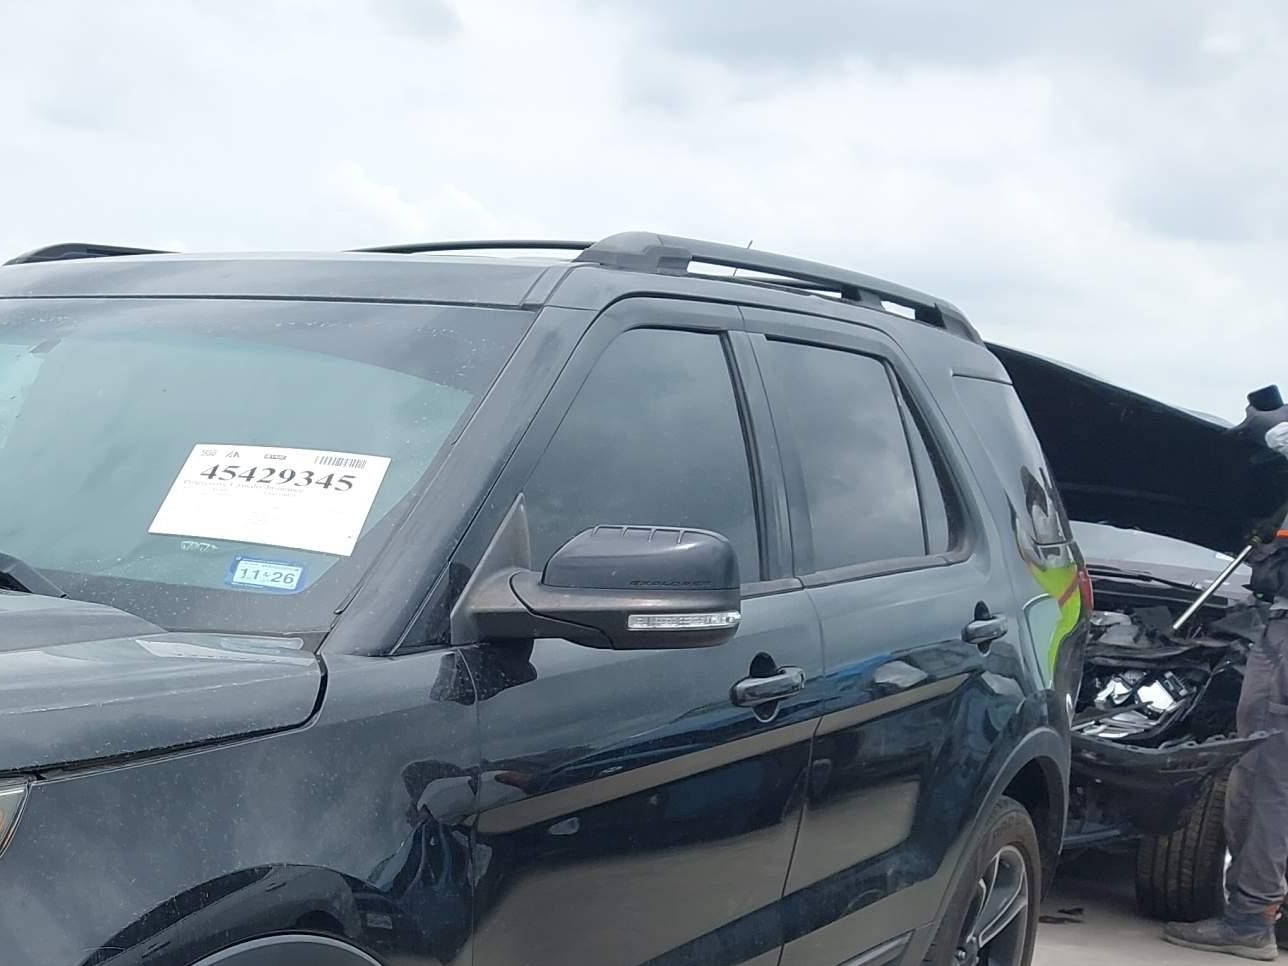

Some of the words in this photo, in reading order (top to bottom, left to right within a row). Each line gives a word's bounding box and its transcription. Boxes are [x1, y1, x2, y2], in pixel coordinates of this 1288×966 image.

[200, 463, 356, 492] 45429345
[239, 567, 260, 580] 11
[270, 571, 296, 584] 26
